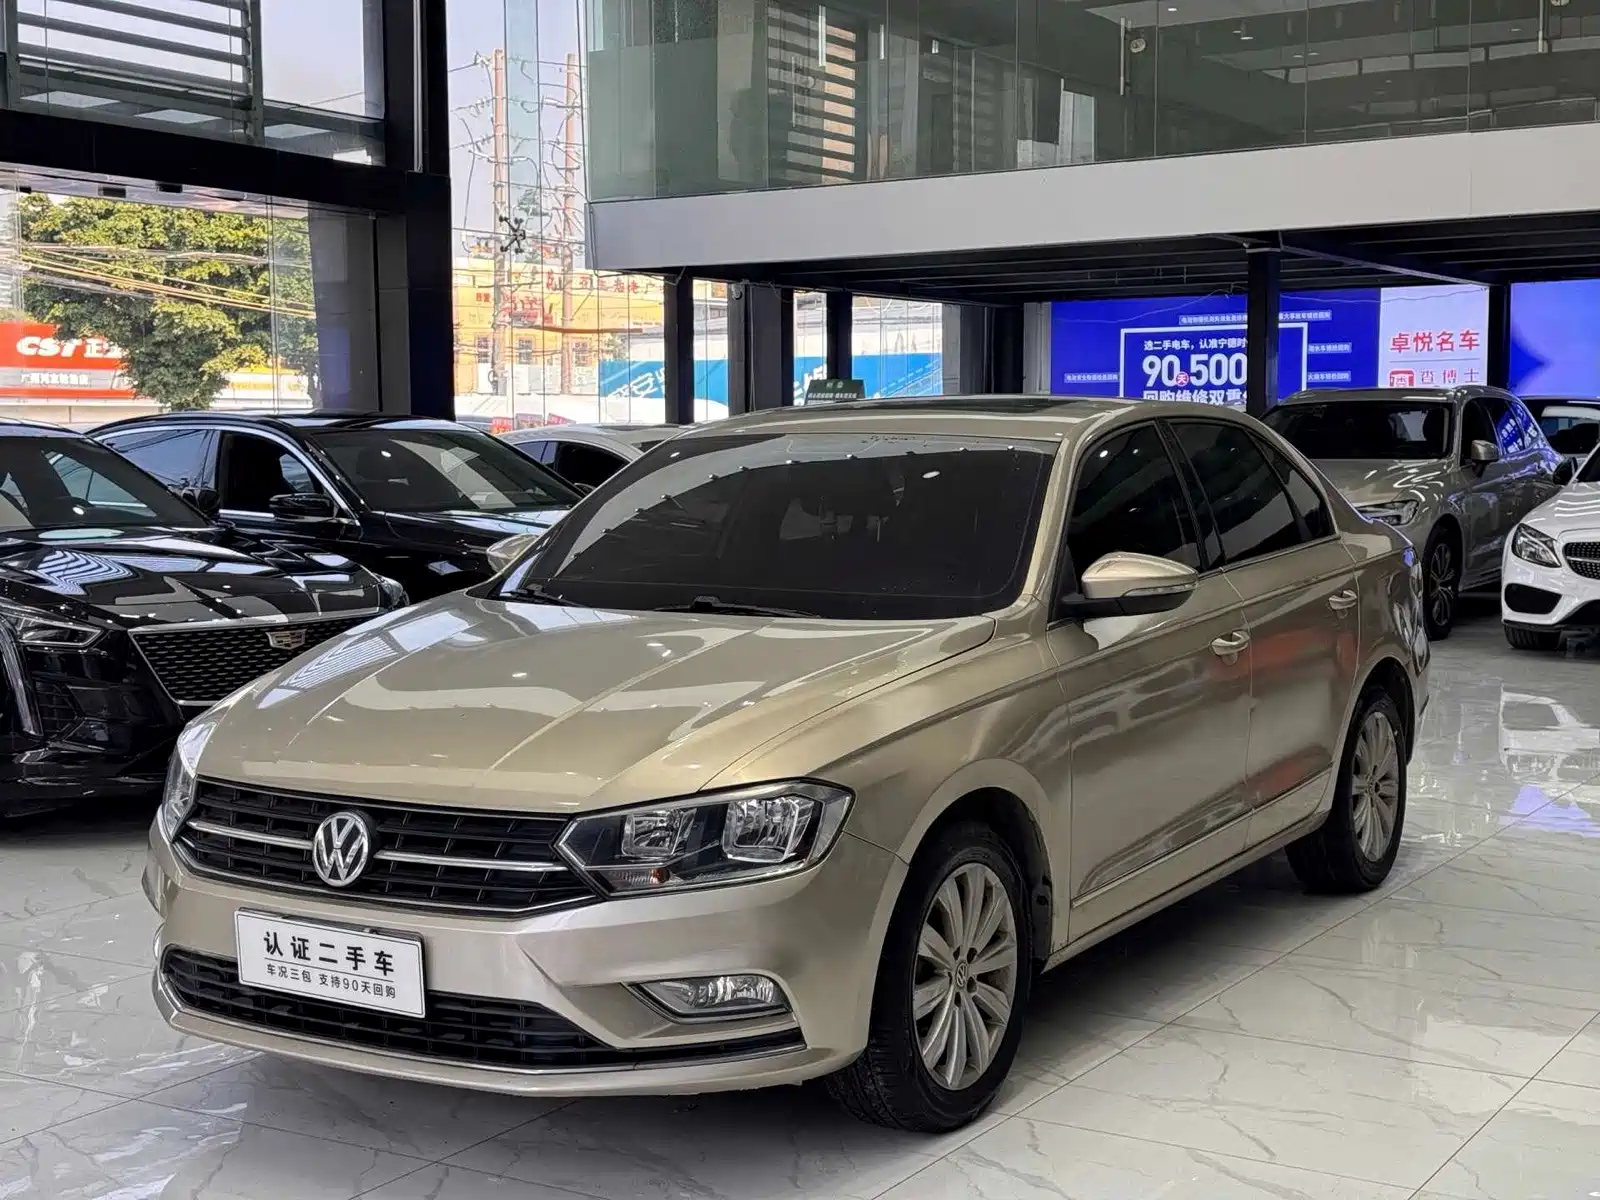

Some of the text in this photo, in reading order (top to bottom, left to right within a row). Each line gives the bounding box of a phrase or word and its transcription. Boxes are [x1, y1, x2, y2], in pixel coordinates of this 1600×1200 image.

[1390, 330, 1480, 353] 卓悦名车
[263, 931, 394, 976] 认证二手车
[266, 963, 396, 999] 车况三包 支持90天回购
